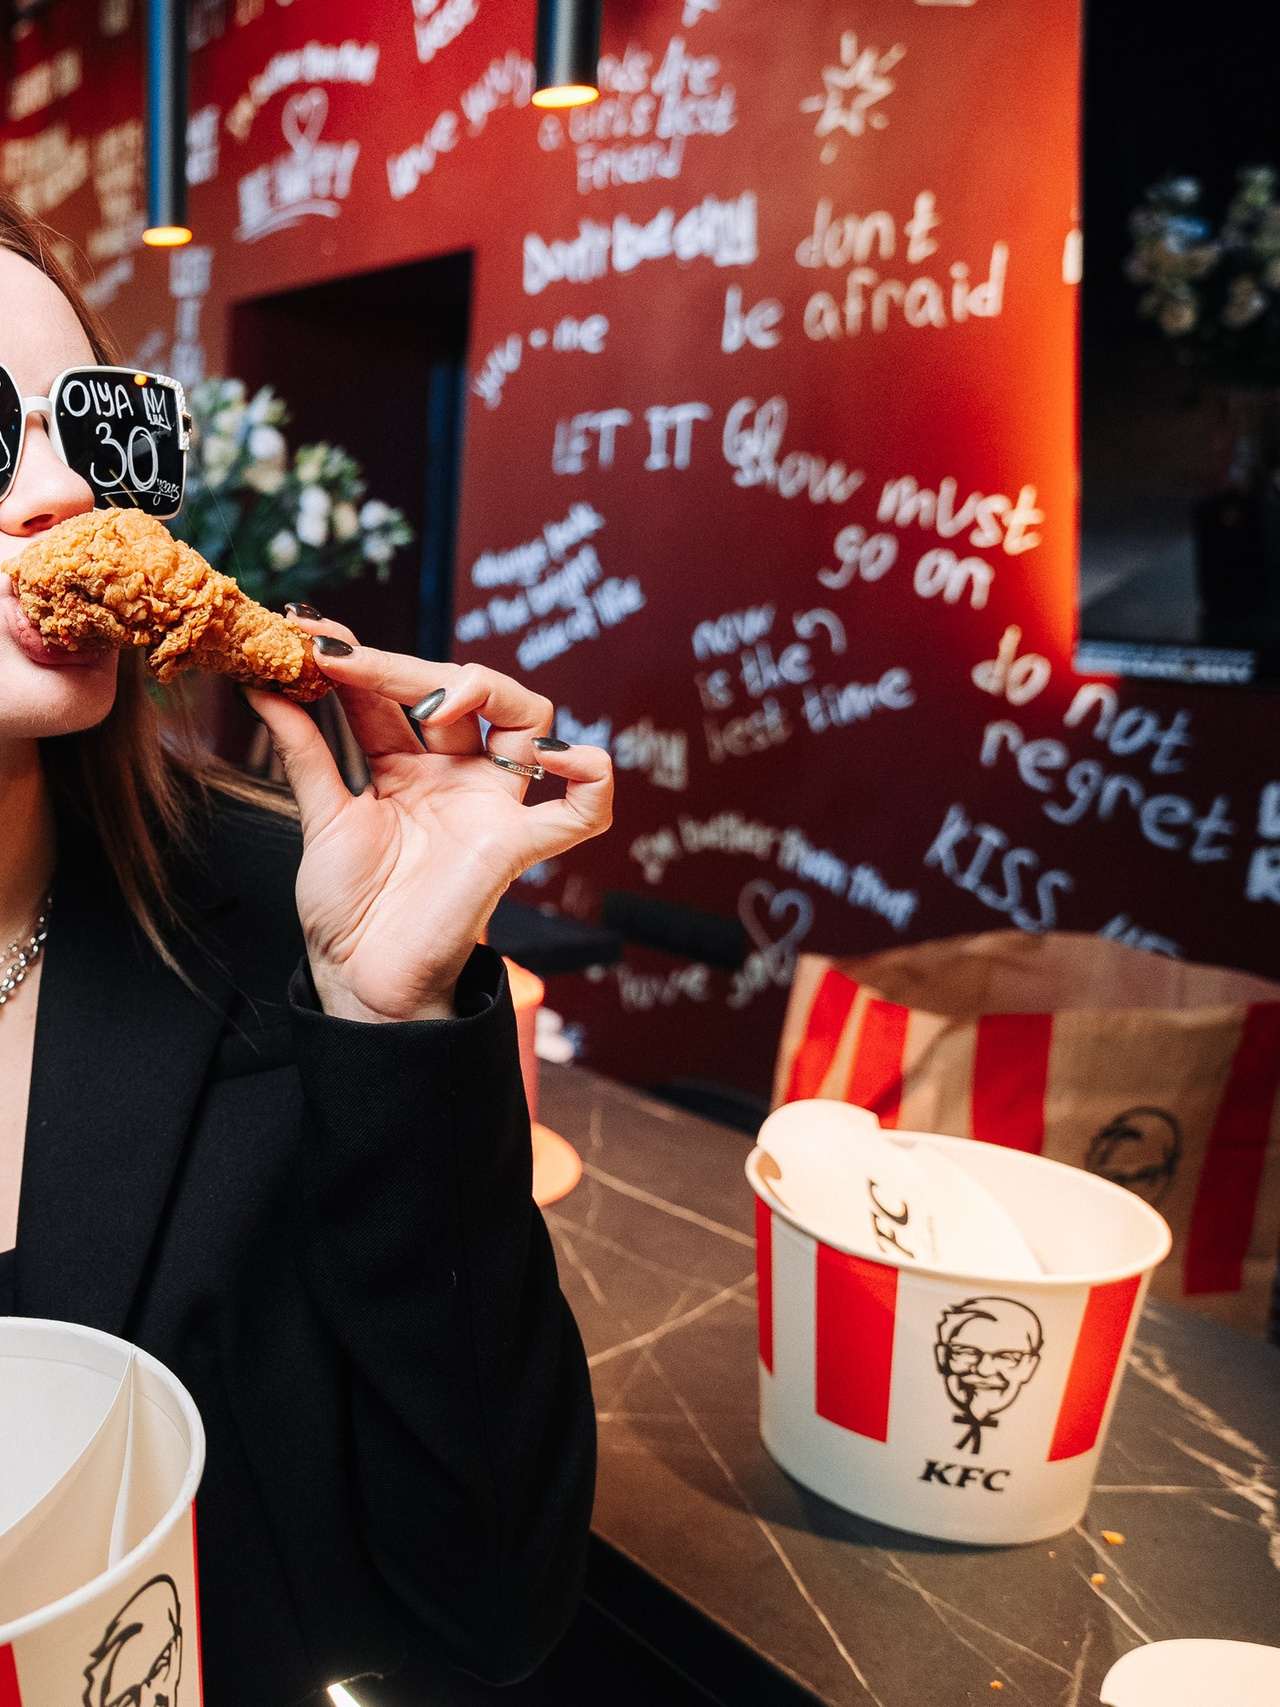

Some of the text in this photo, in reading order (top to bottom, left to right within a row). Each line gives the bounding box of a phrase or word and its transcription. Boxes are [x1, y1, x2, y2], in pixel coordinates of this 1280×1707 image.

[722, 283, 784, 354] be
[803, 240, 1009, 342] afraid
[89, 421, 159, 492] 30
[551, 407, 632, 474] LET
[644, 401, 713, 472] IT
[817, 523, 995, 611] go on
[739, 641, 816, 699] the
[801, 665, 918, 734] time
[970, 624, 1053, 706] do
[1062, 682, 1193, 775] not
[979, 718, 1239, 864] regret
[923, 803, 1076, 935] KISS
[918, 1459, 1012, 1494] KFC
